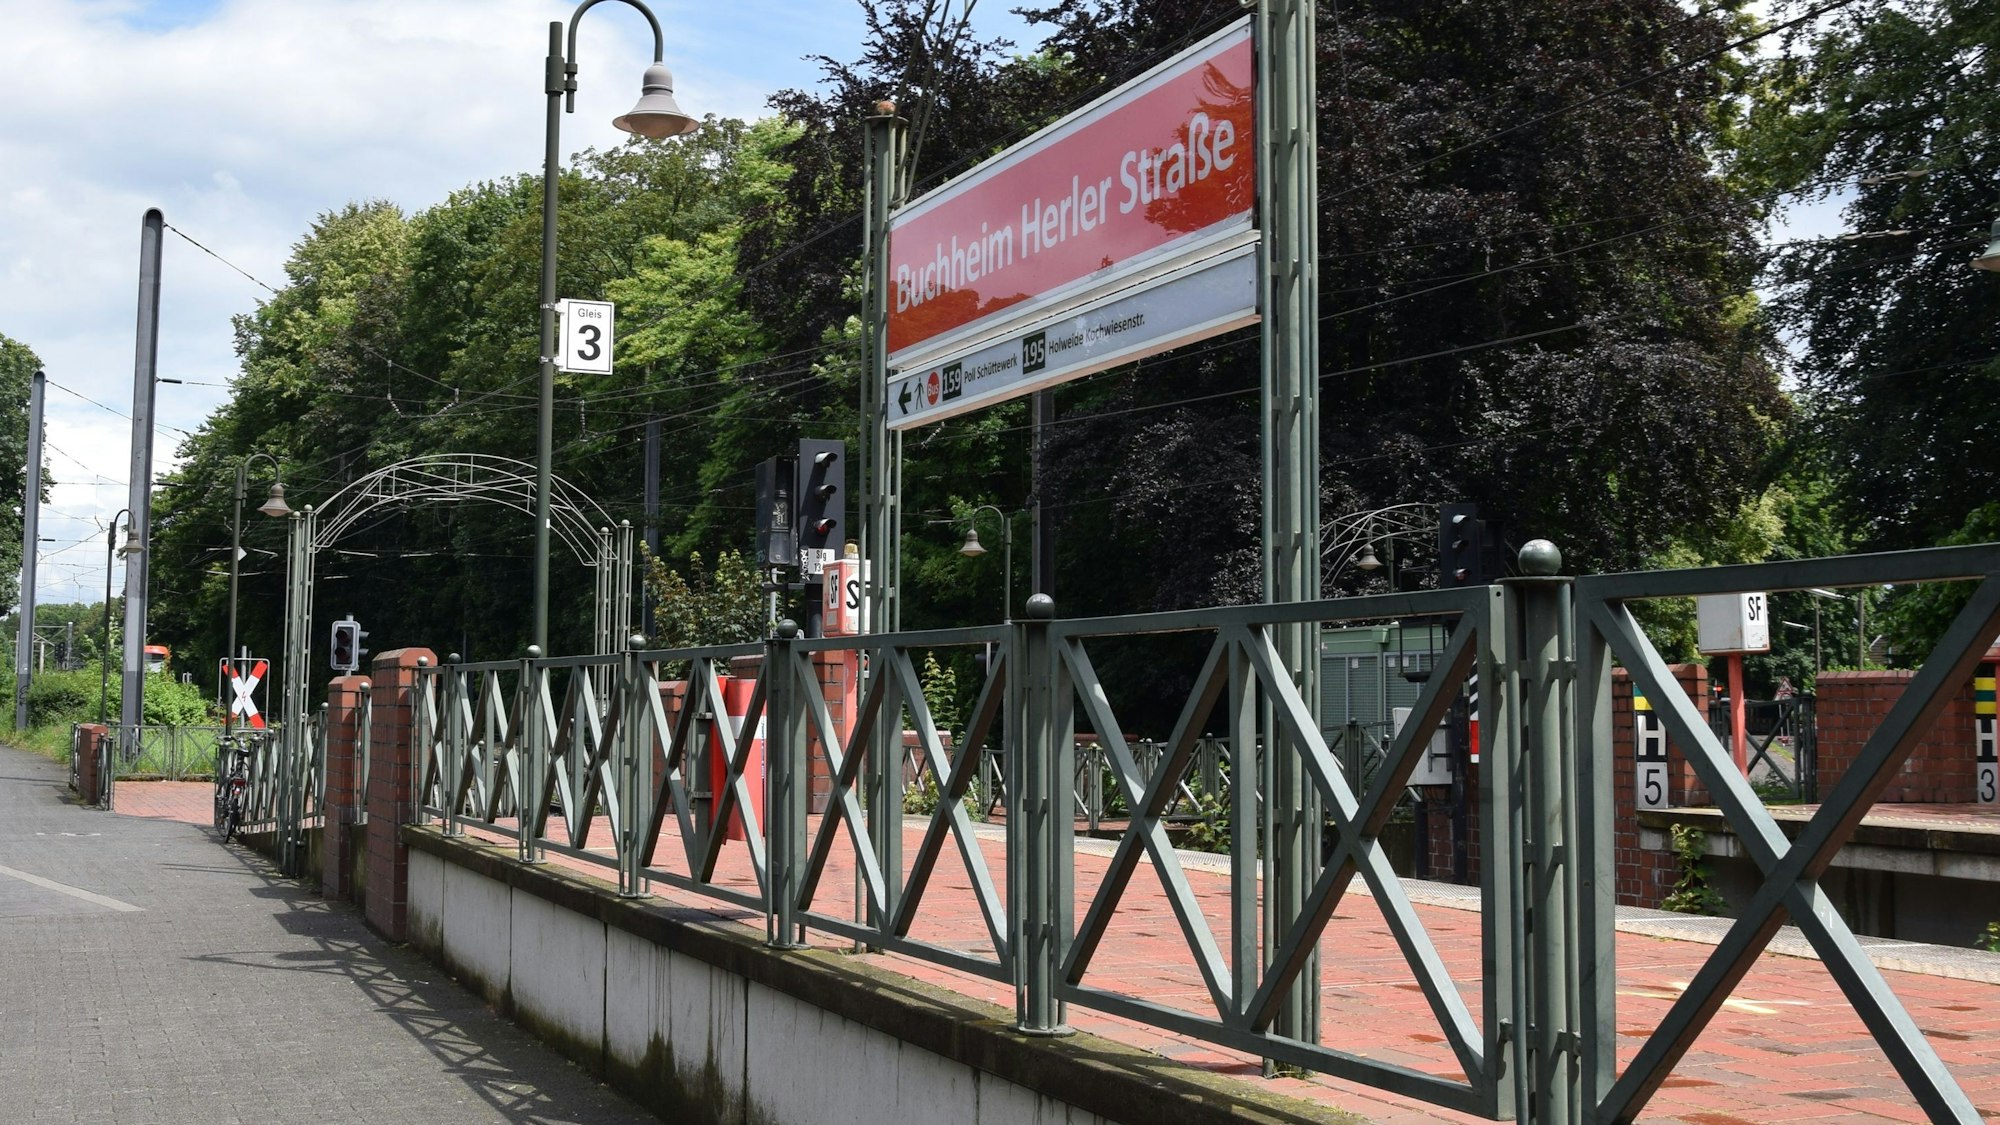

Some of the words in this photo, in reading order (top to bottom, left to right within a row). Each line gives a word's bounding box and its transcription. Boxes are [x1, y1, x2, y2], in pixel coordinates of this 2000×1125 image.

[897, 221, 1013, 314] Buchheim
[1021, 175, 1112, 259] Herler
[1119, 111, 1235, 214] Straße
[577, 308, 602, 319] Gleis
[577, 324, 601, 361] 3
[927, 382, 940, 396] Bus
[943, 368, 961, 395] 159
[964, 369, 975, 384] Poll
[977, 354, 1018, 380] Schüttewerk
[1023, 339, 1044, 367] 195
[1048, 331, 1084, 355] Holweide
[1084, 313, 1146, 343] Kochwiesenstr.
[816, 550, 827, 561] Sig
[830, 575, 838, 604] SF
[1748, 596, 1761, 621] SF
[1637, 714, 1666, 756] H
[1976, 719, 1997, 757] H
[1644, 769, 1662, 806] 5
[1980, 768, 1996, 803] 3
